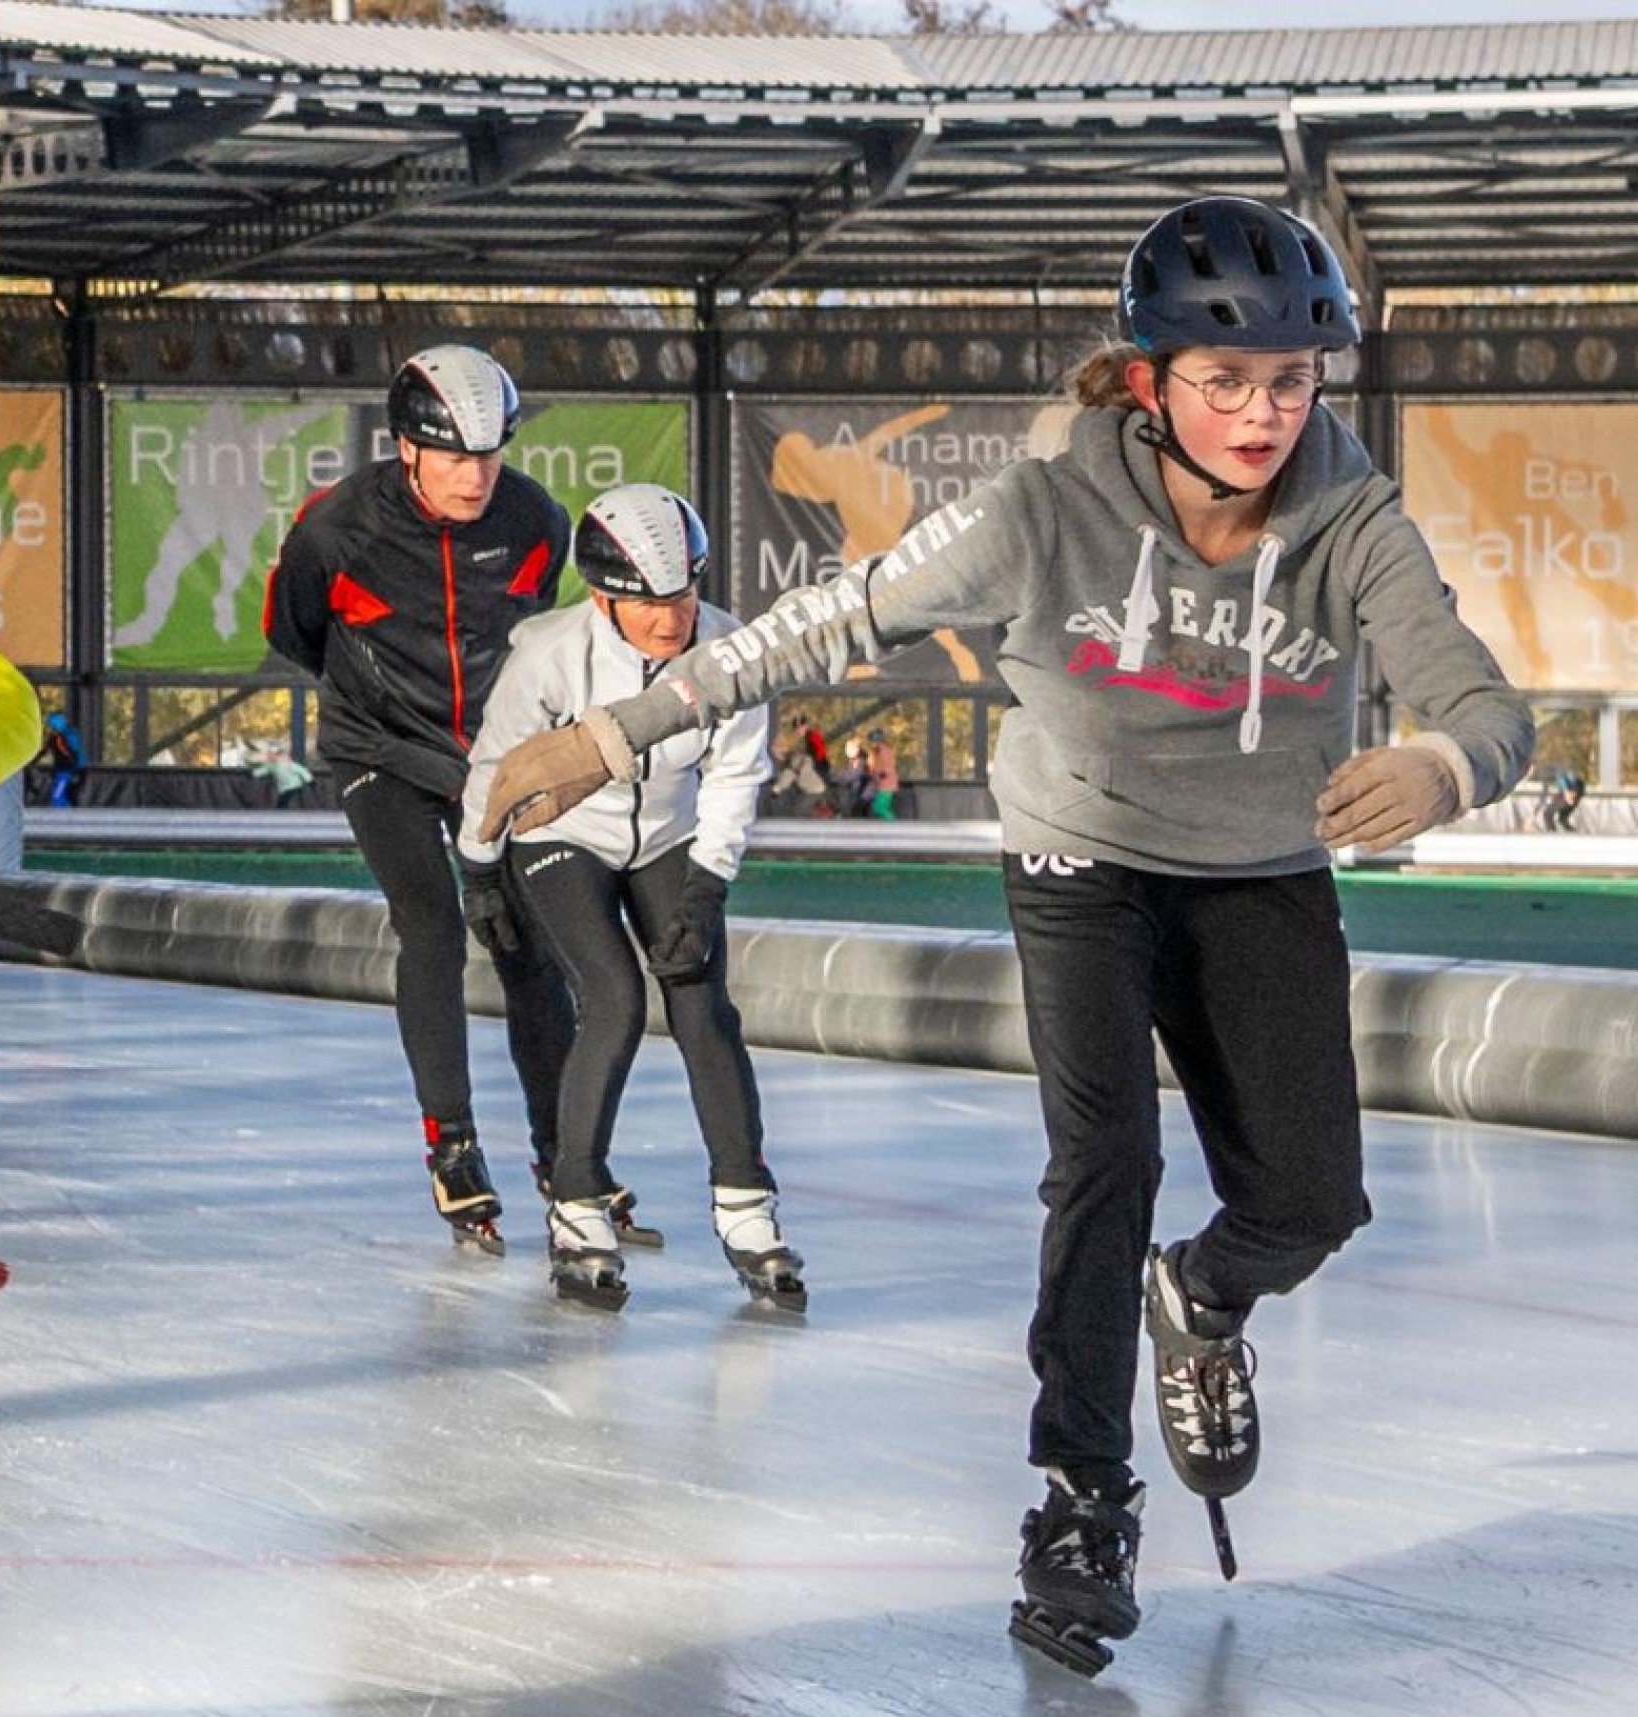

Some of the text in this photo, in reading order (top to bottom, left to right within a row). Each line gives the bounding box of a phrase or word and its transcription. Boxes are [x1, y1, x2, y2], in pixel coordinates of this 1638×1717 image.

[128, 426, 345, 500] Rintje
[1525, 459, 1619, 500] Ben
[1427, 513, 1625, 579] Falko
